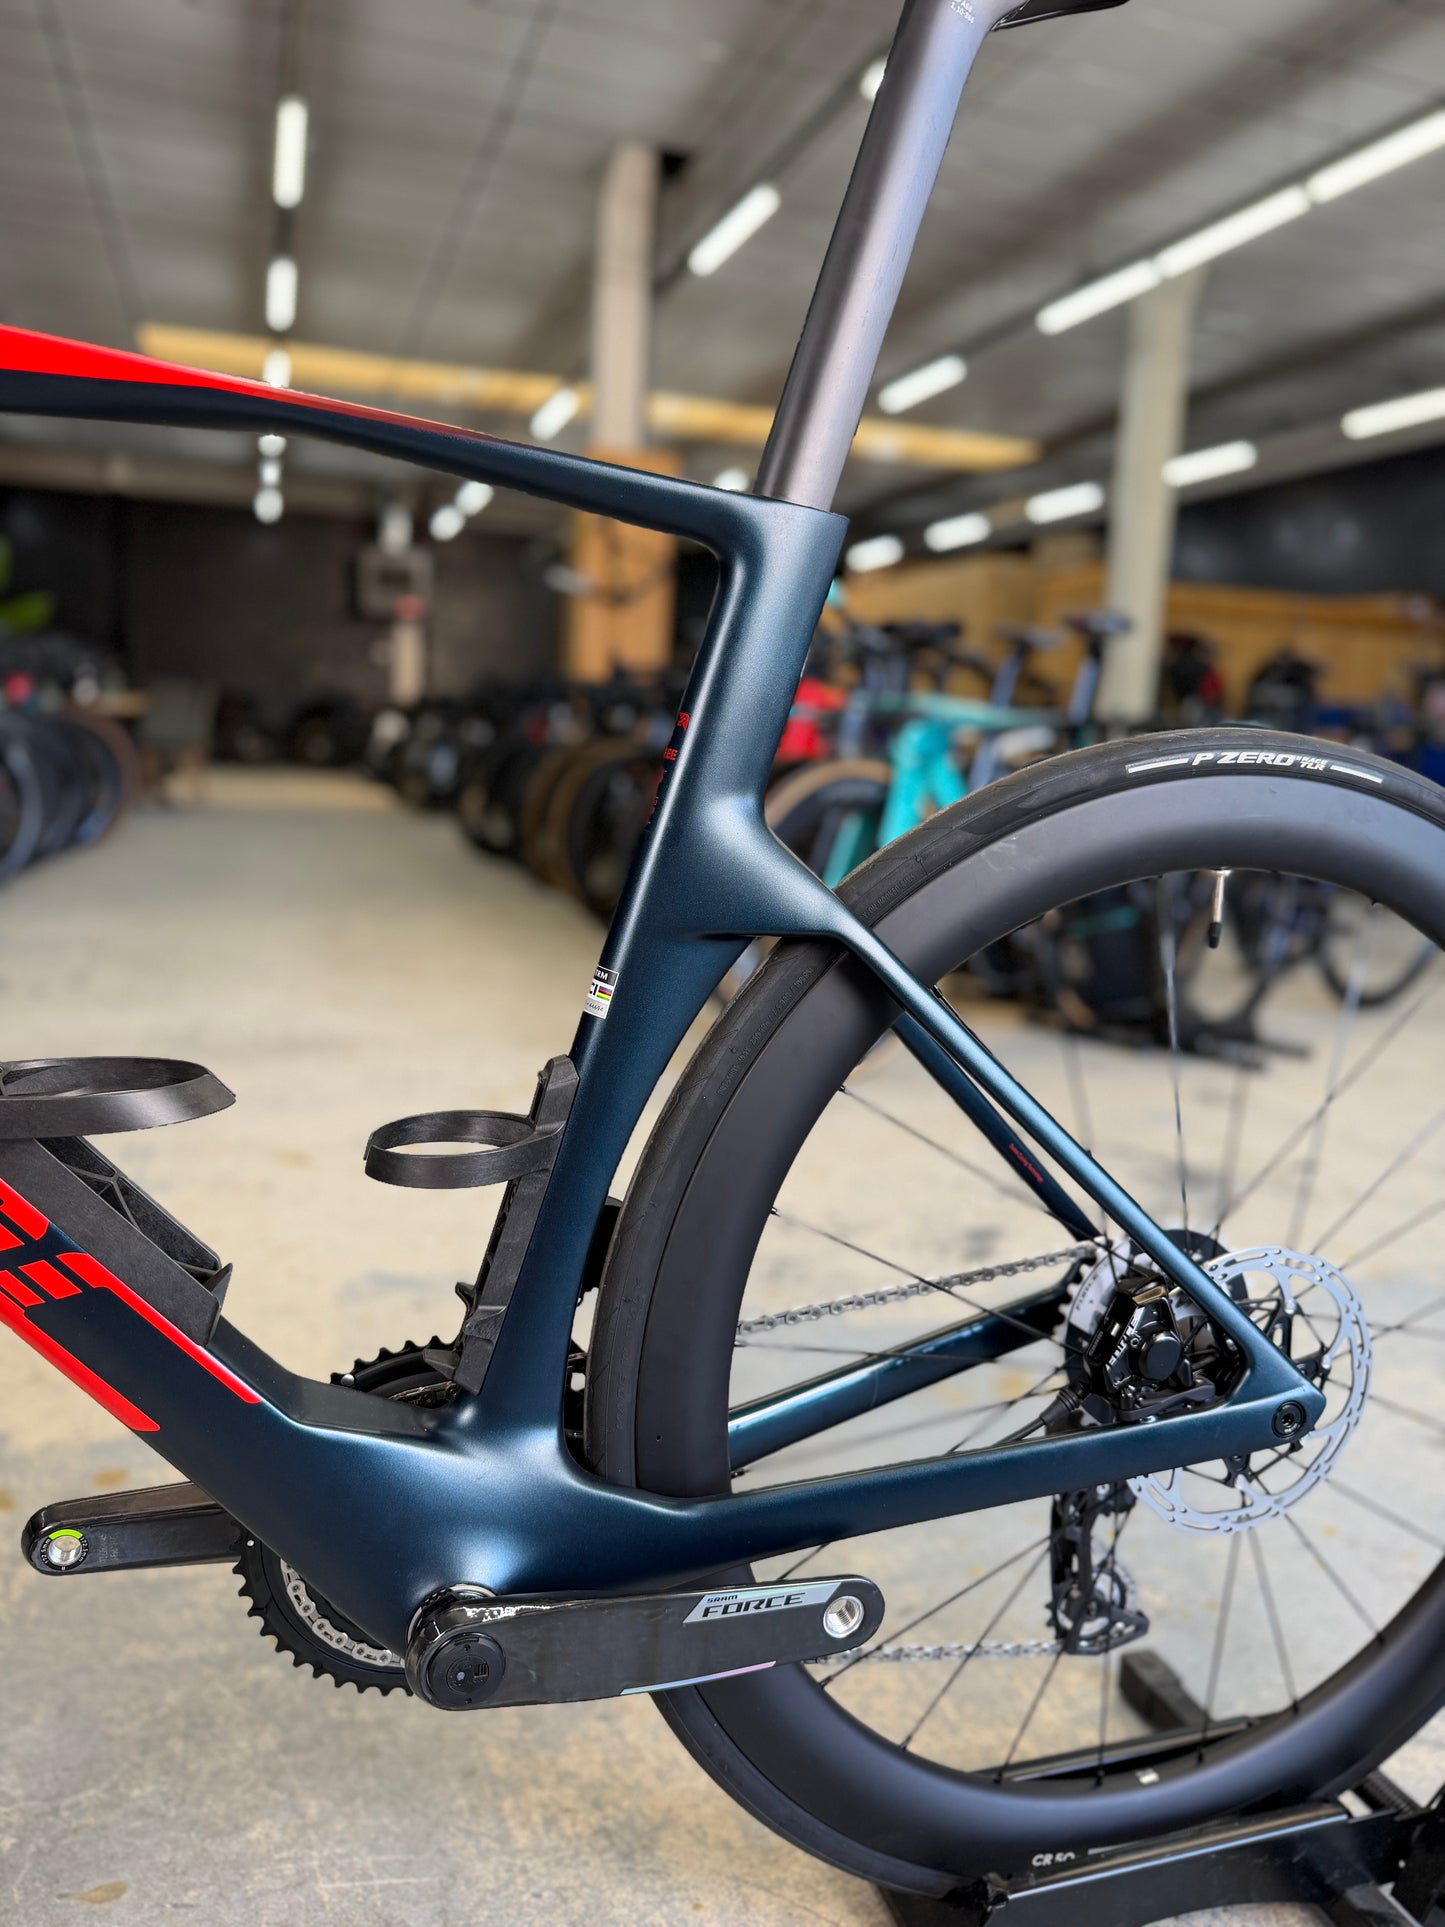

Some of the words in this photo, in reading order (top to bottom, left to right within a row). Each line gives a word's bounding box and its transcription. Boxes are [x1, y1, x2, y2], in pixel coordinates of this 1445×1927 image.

[1191, 752, 1215, 766] P
[1217, 751, 1296, 767] ZERO
[1299, 762, 1326, 771] TLR
[702, 1592, 806, 1618] FORCE
[706, 1594, 738, 1604] SRAM
[1031, 1852, 1054, 1867] CR
